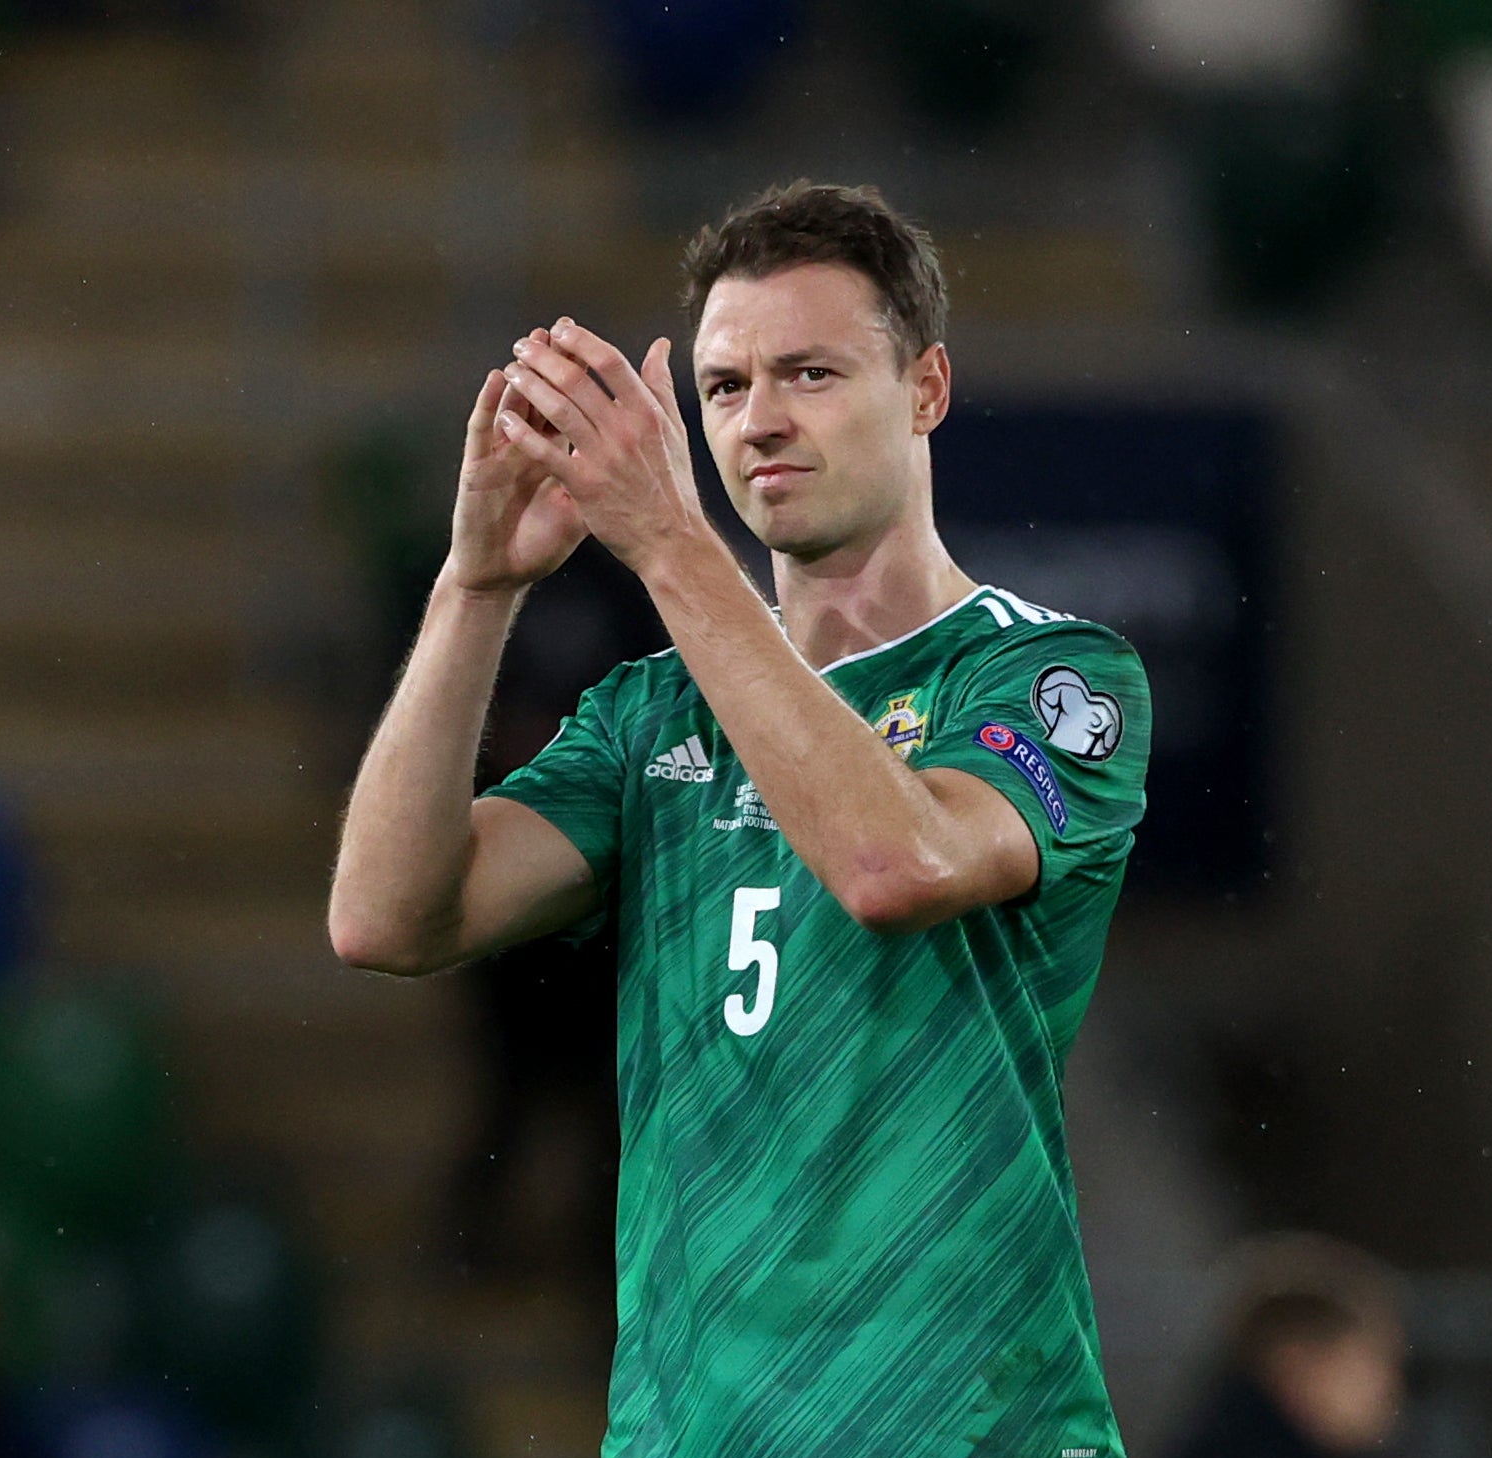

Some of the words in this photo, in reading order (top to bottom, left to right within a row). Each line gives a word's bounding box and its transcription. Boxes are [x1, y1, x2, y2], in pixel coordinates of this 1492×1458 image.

[644, 763, 714, 783] adidas
[1013, 743, 1066, 828] RESPECT
[723, 886, 781, 1037] 5
